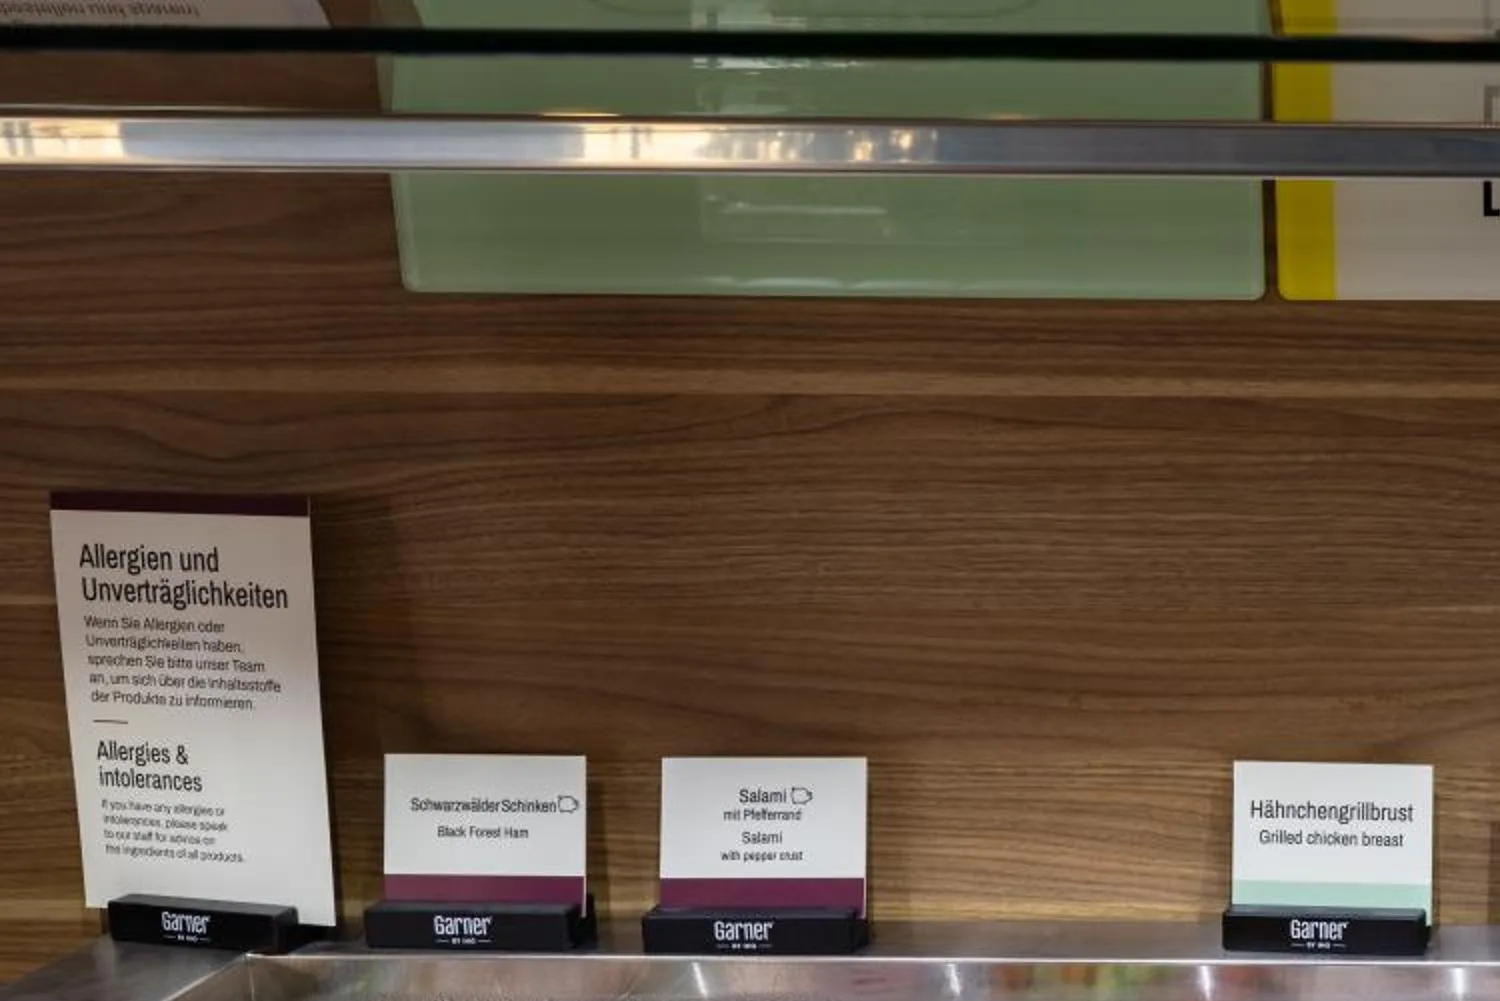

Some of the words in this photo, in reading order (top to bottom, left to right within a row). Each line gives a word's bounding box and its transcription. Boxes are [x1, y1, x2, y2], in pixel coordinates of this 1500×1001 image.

[80, 543, 173, 575] Allergien
[179, 546, 219, 573] und
[81, 576, 289, 611] Unverträglichkeiten
[84, 615, 119, 629] Wenn
[121, 617, 140, 630] Sie
[144, 618, 195, 634] Allergien
[197, 620, 225, 633] oder
[145, 655, 164, 669] Sie
[232, 659, 265, 673] Team
[97, 740, 171, 767] Allergies
[176, 744, 189, 765] &
[98, 765, 203, 792] intolerances
[410, 797, 500, 813] Schwarzwälder
[501, 799, 557, 813] Schinken
[739, 788, 787, 804] Salami
[723, 809, 741, 821] mit
[1250, 799, 1414, 825] Hähnchengrillbrust
[437, 825, 467, 839] Black
[469, 826, 501, 839] Forest
[503, 827, 529, 839] Ham
[742, 831, 783, 845] Salami
[1259, 829, 1303, 845] Grilled
[1306, 830, 1358, 846] chicken
[1361, 831, 1404, 847] breast
[433, 915, 492, 936] Garner
[713, 920, 773, 941] Garner
[1289, 919, 1348, 941] Garner
